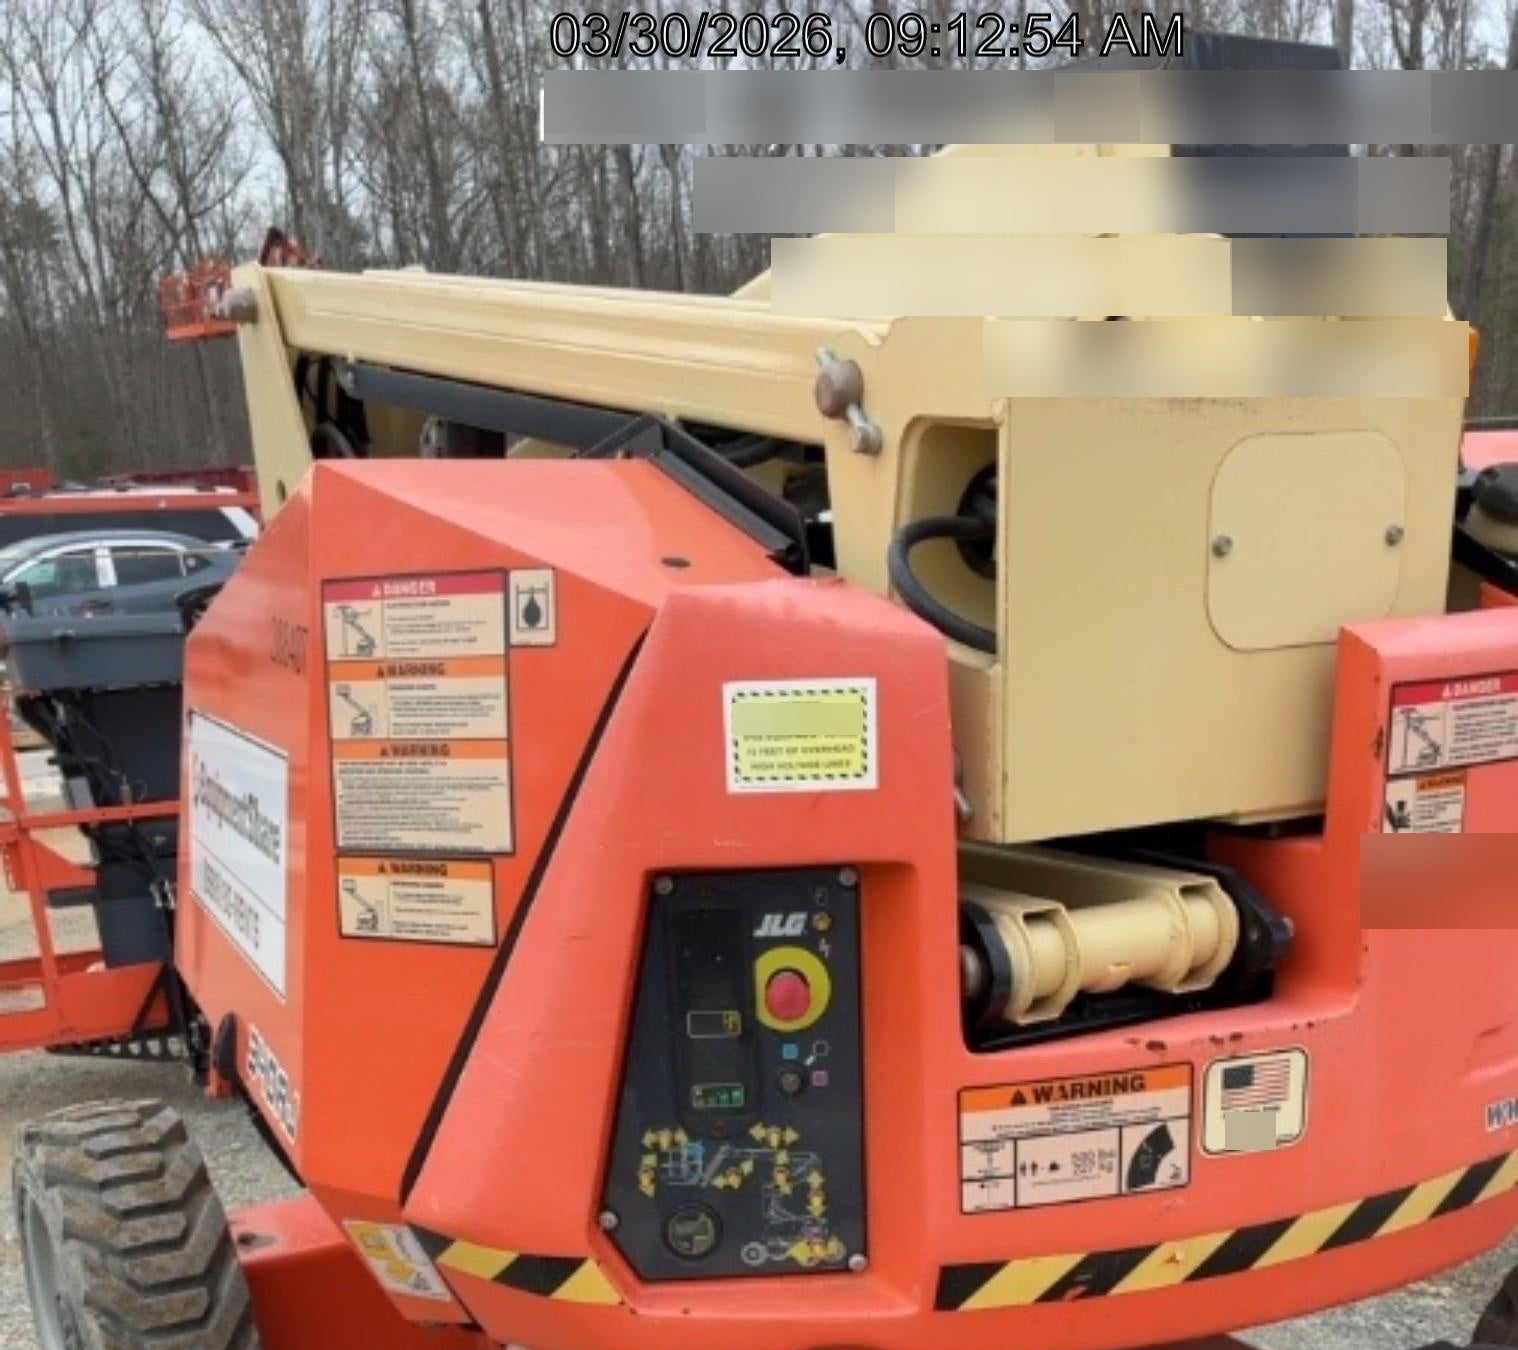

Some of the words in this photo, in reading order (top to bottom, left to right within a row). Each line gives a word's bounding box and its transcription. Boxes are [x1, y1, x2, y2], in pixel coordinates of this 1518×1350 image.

[383, 580, 437, 597] DANGER
[386, 662, 446, 678] WARNING
[1453, 678, 1501, 698] DANGER
[390, 743, 451, 758] WARNING
[389, 862, 448, 878] WARNING
[752, 911, 808, 938] JLG
[1031, 1074, 1147, 1105] WARNING
